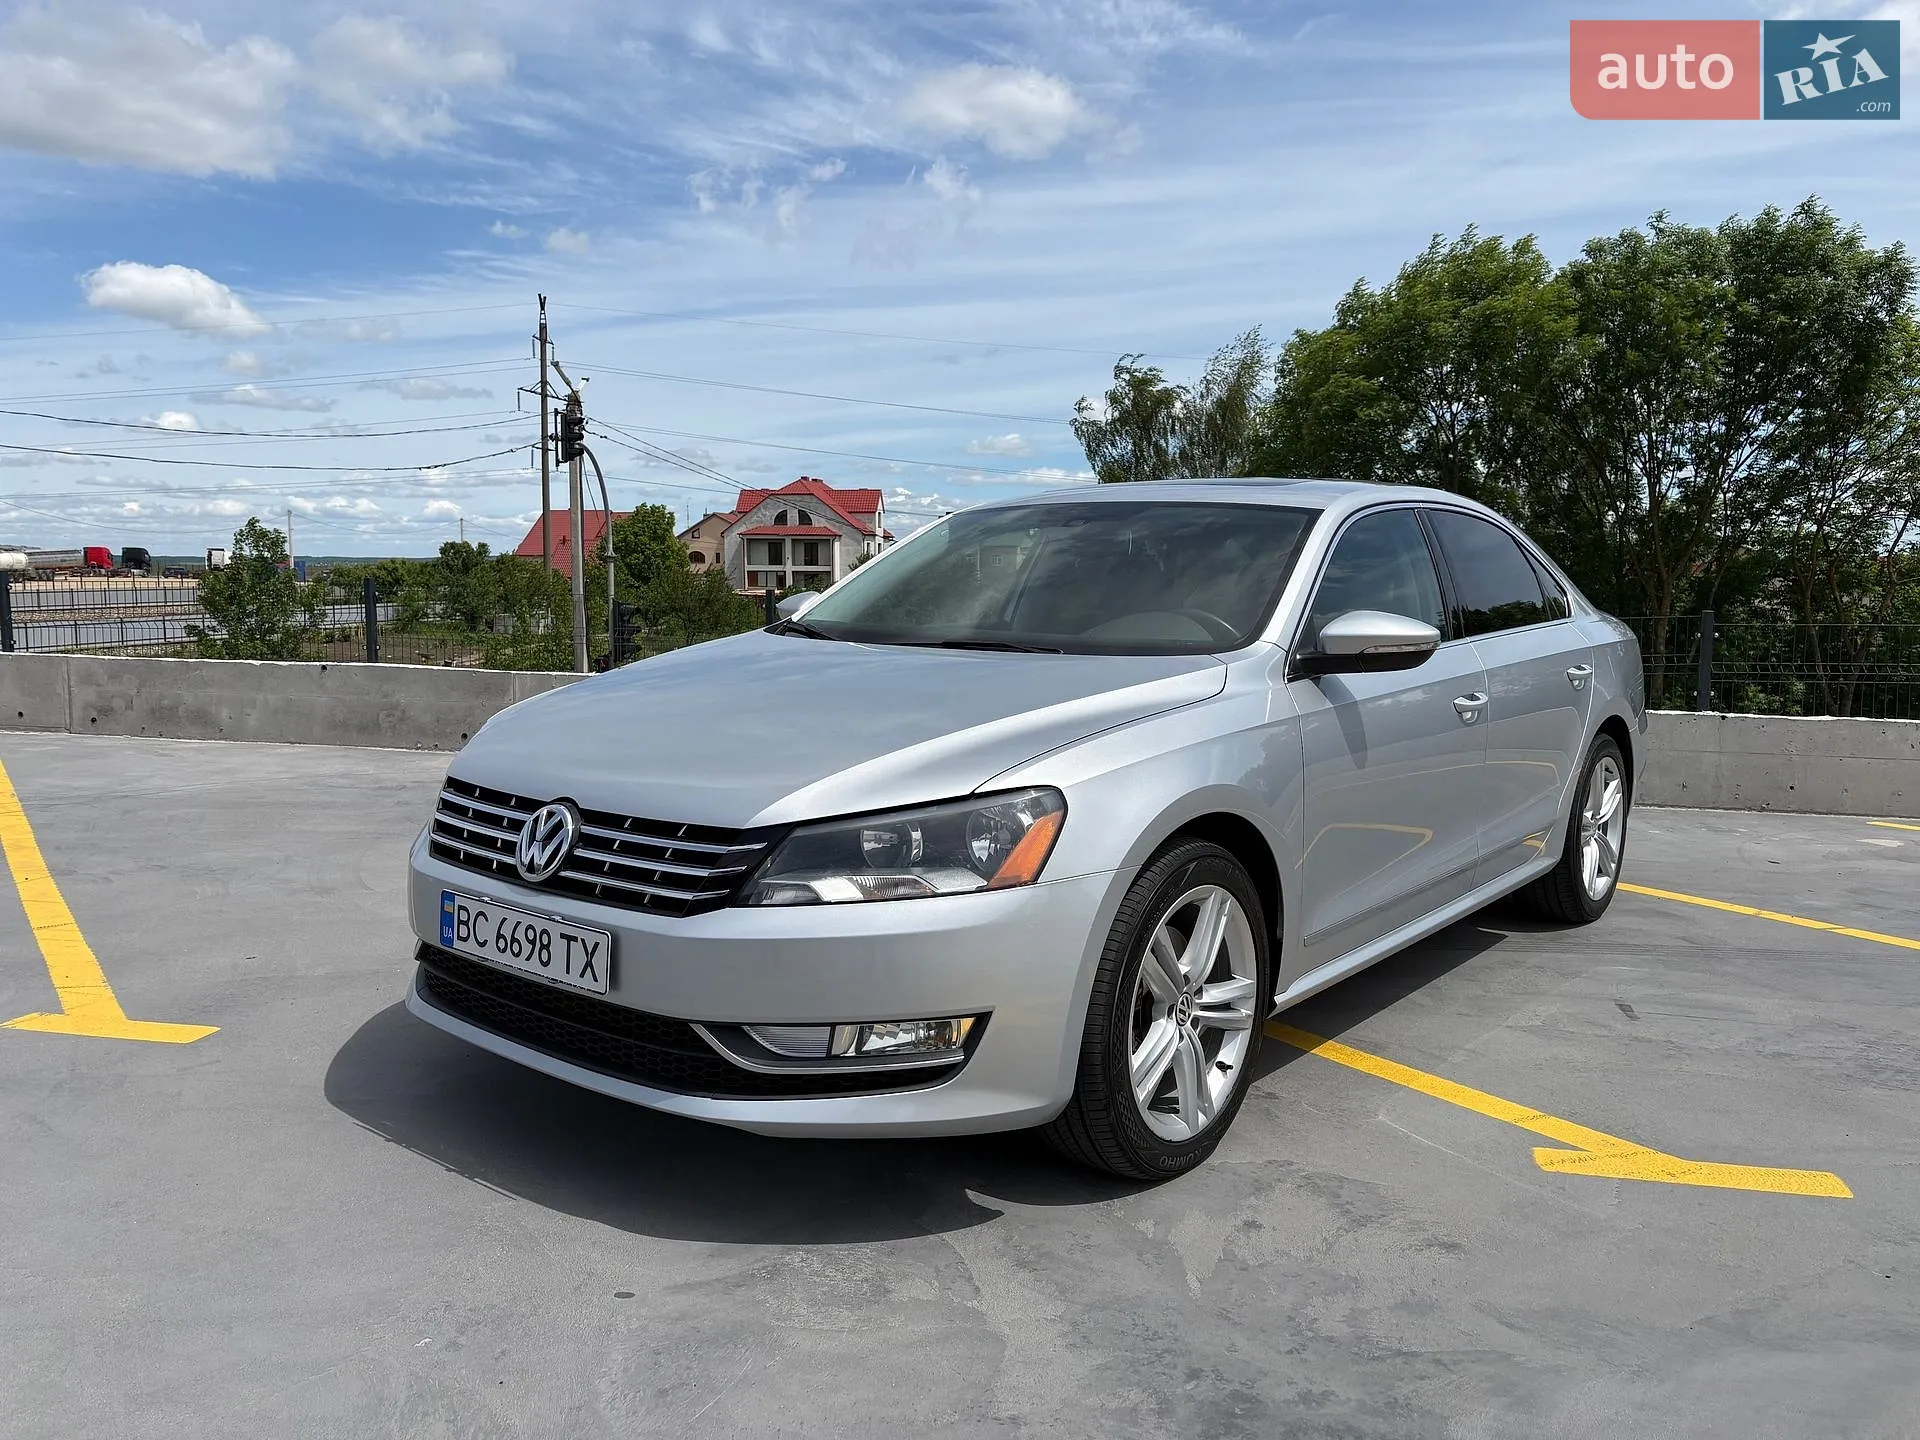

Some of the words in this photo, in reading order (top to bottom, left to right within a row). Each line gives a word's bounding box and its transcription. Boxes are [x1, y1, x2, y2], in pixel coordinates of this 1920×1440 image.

[443, 925, 453, 939] UA
[457, 904, 489, 948] BC
[495, 917, 552, 968] 6698
[560, 932, 600, 983] TX
